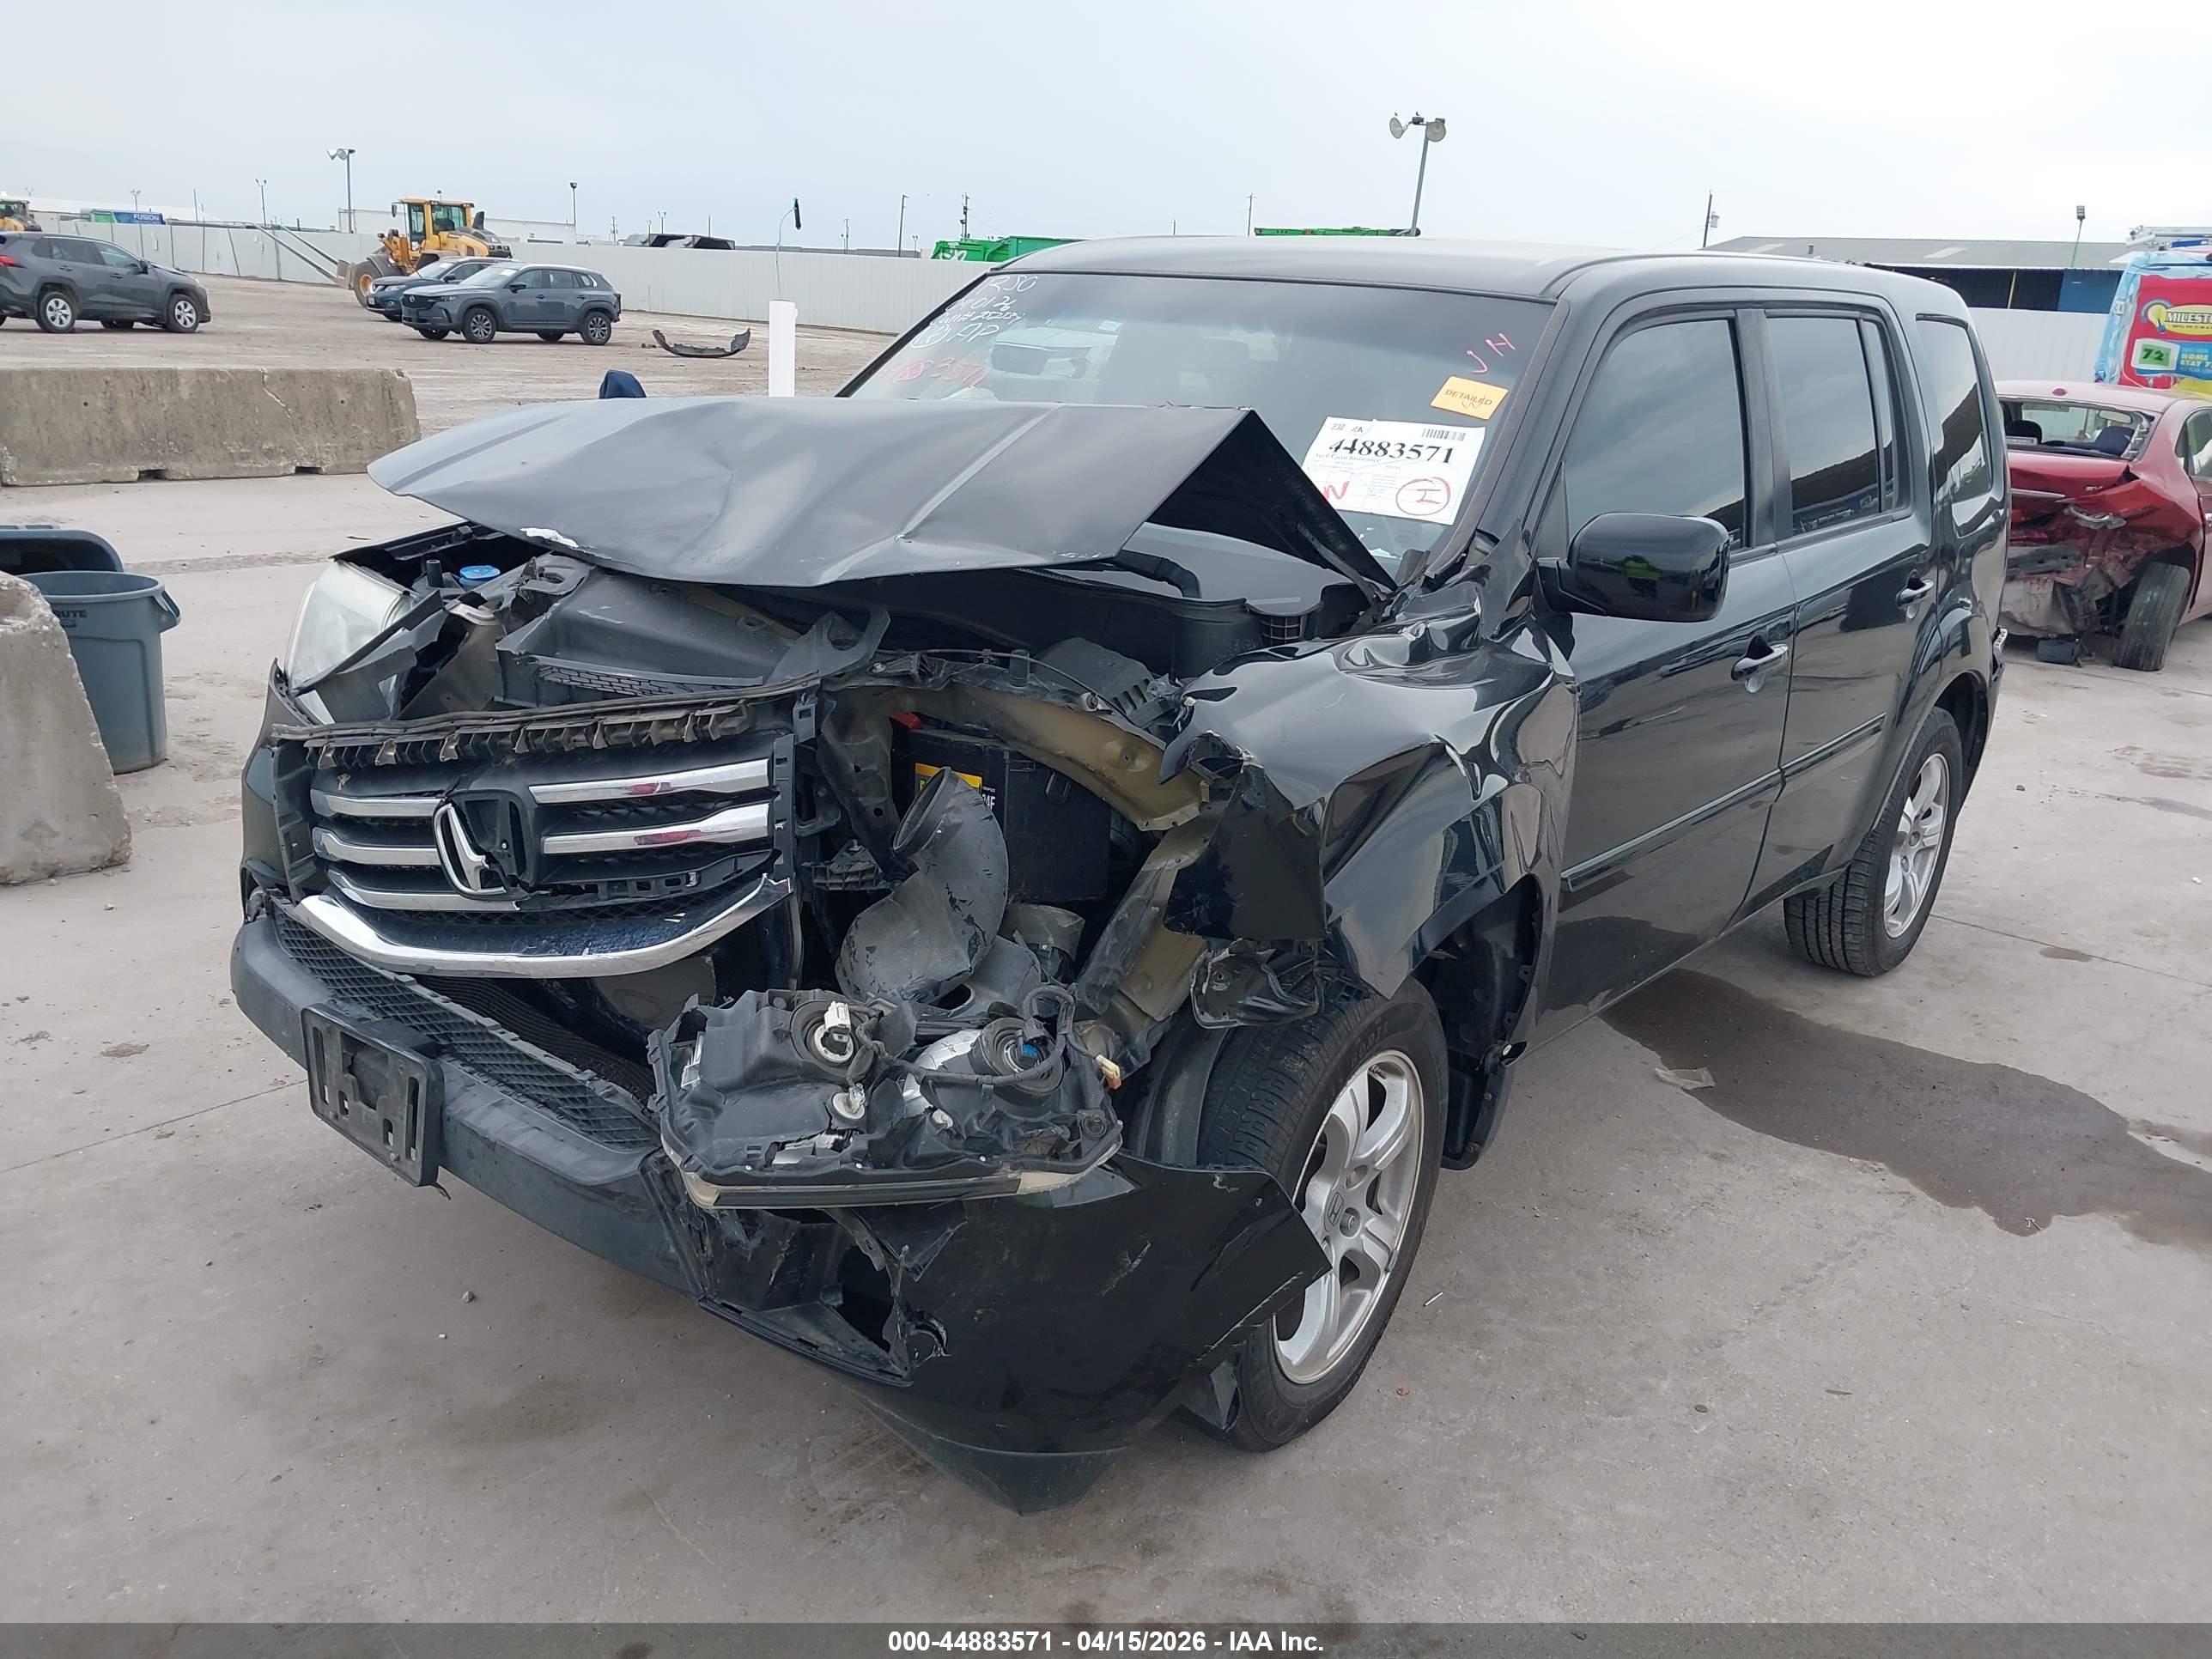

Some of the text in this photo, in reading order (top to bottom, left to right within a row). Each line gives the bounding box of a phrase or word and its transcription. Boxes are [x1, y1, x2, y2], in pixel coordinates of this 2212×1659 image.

[133, 212, 160, 222] FUSION
[1445, 389, 1492, 406] DETAILED
[1328, 438, 1455, 464] 44883571
